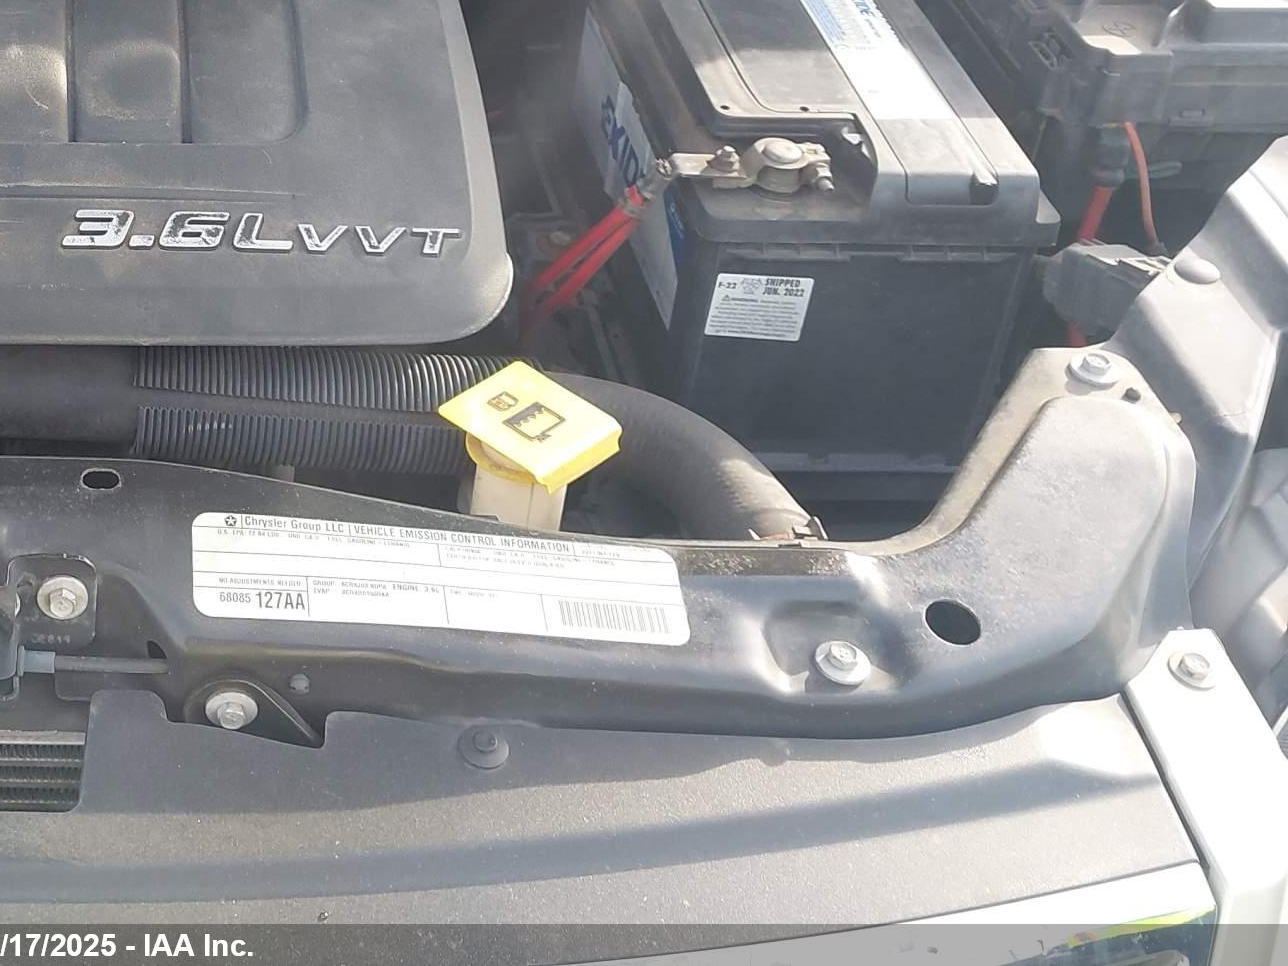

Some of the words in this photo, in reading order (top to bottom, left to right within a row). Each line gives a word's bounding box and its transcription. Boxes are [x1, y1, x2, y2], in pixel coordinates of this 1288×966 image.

[765, 278, 801, 288] SHIPPED
[783, 288, 805, 297] 2022
[244, 515, 288, 530] Chrysler
[290, 519, 322, 532] Group
[325, 521, 345, 533] LLC
[353, 525, 395, 538] VEHICLE
[399, 528, 448, 542] EMISSION
[450, 533, 497, 547] CONTROL
[500, 538, 570, 553] INFORMATION
[219, 591, 252, 604] 68085
[255, 591, 306, 611] 127AA
